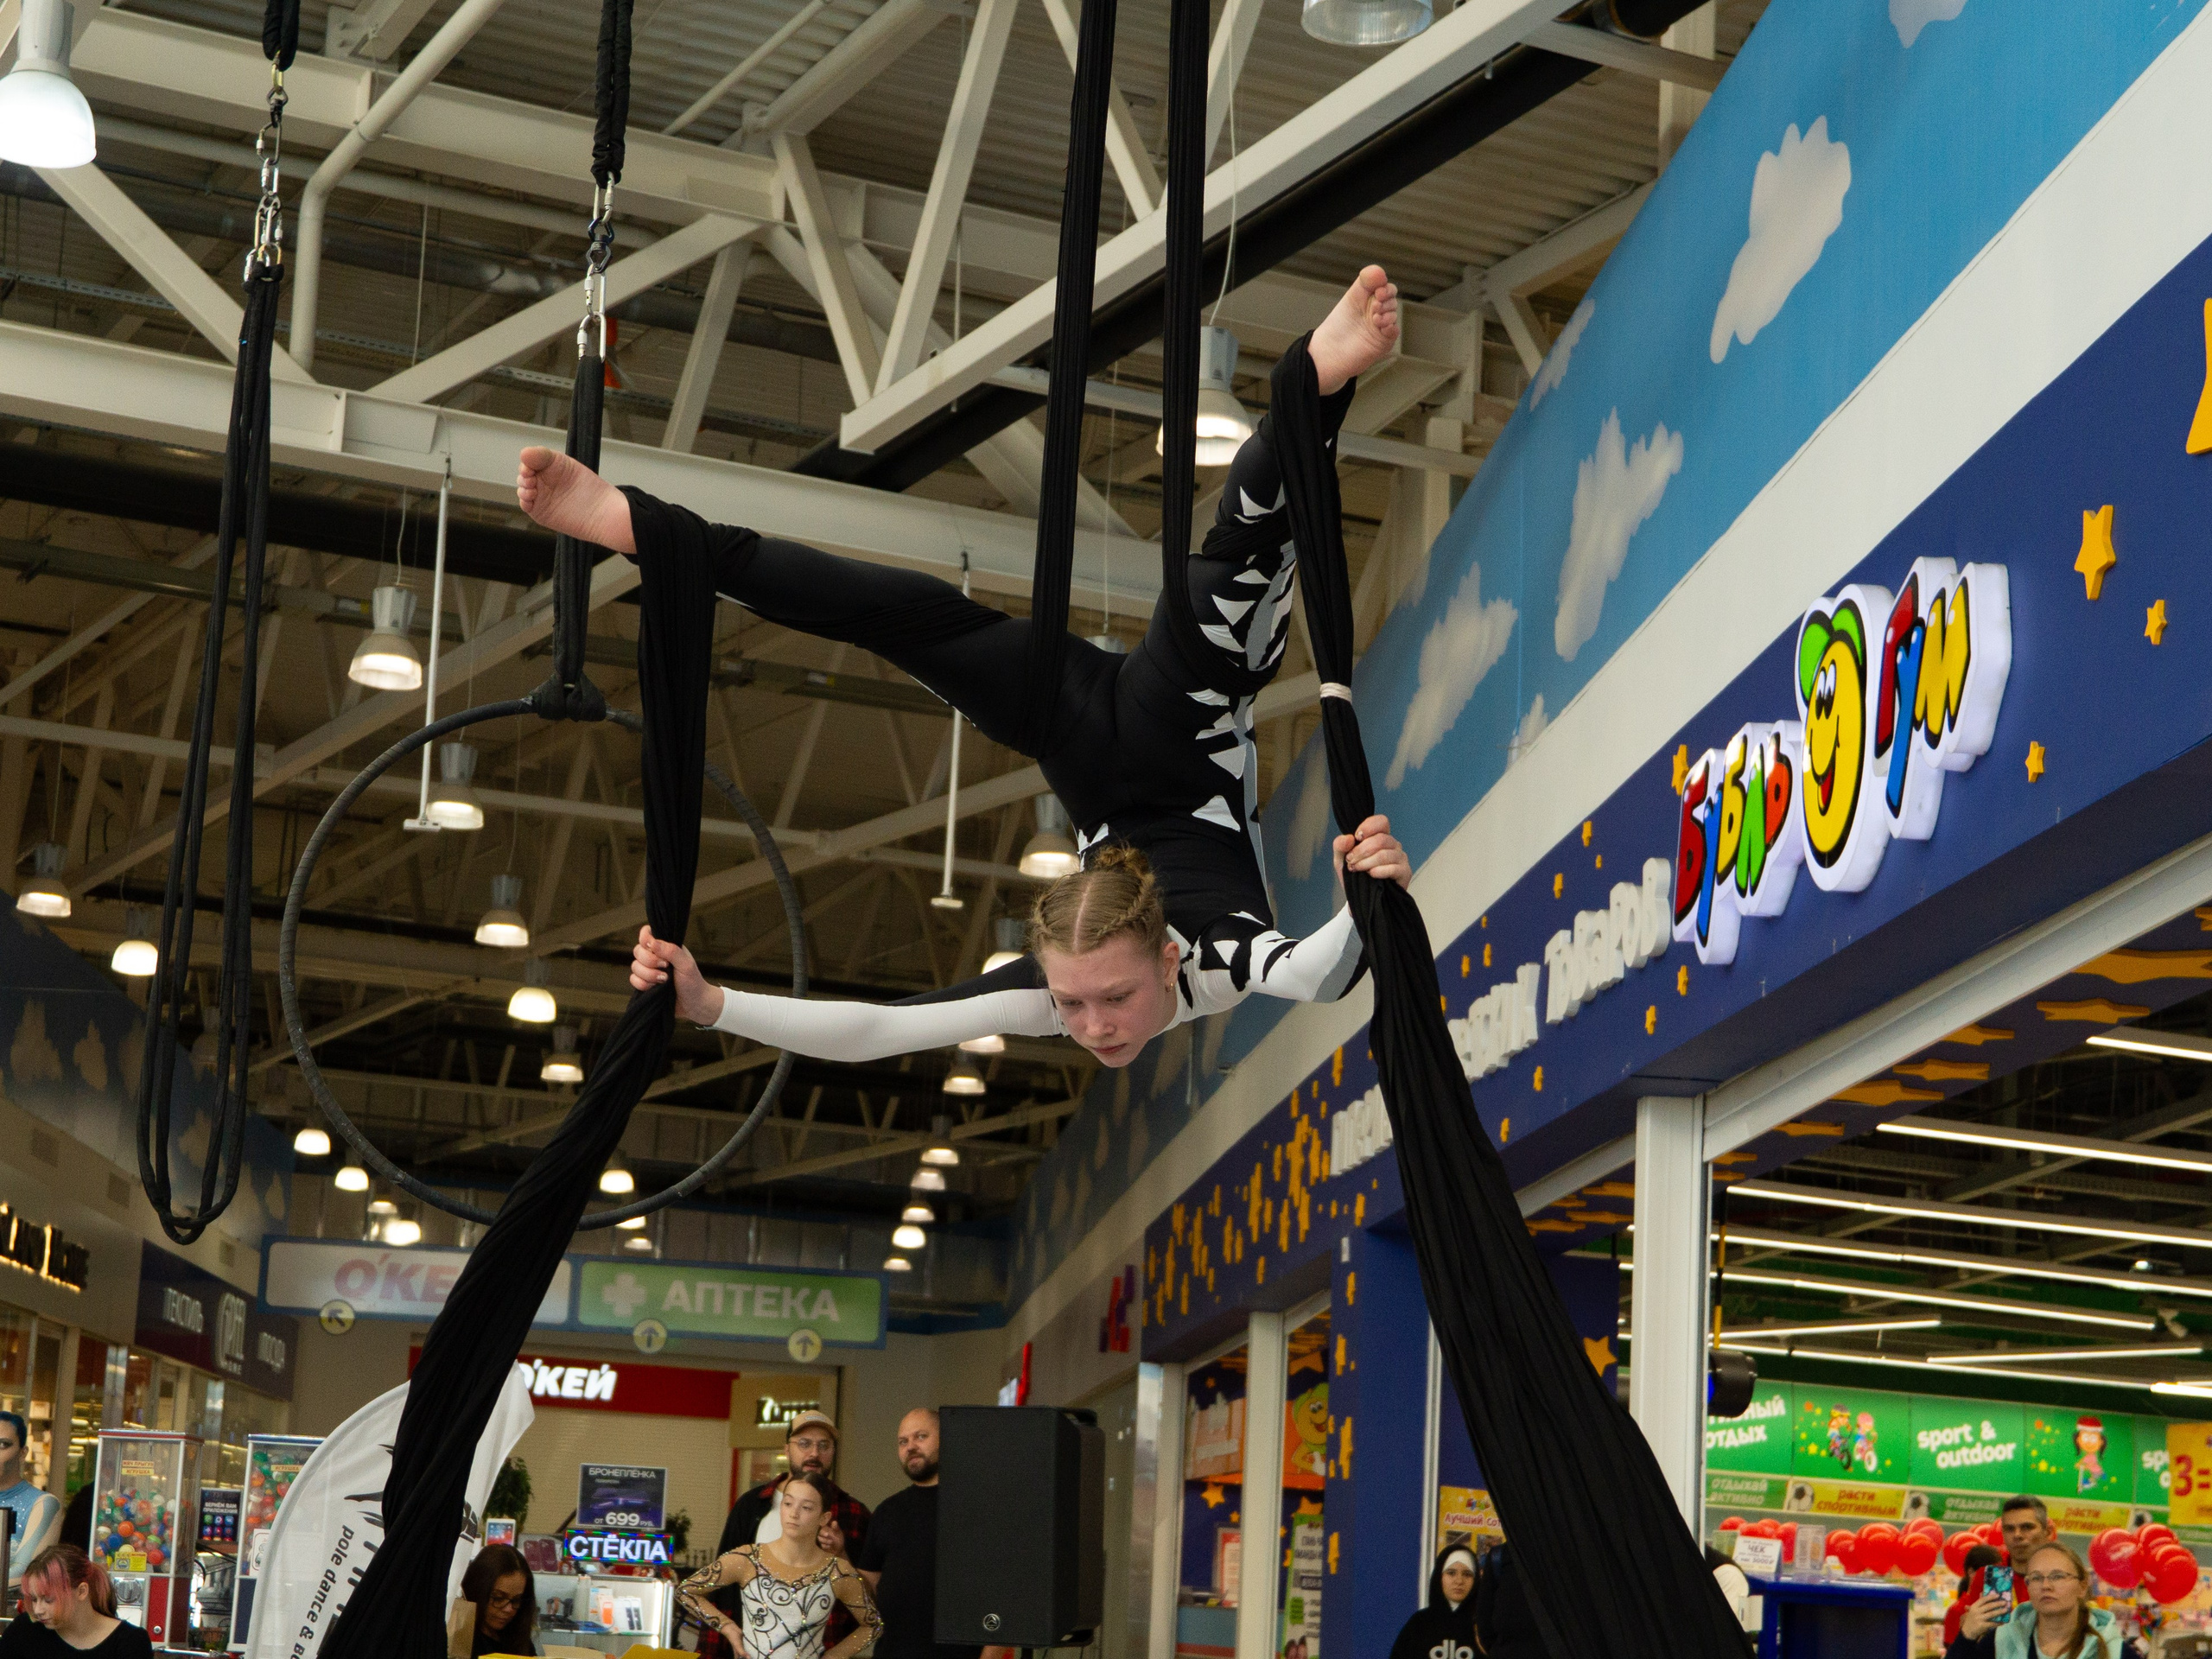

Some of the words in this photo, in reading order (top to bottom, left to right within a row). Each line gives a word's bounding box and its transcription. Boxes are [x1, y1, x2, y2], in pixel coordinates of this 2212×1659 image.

[662, 1280, 840, 1323] АПТЕКА
[1916, 1423, 1974, 1452] sport
[1980, 1420, 1997, 1441] &
[1936, 1442, 2017, 1469] outdoor
[605, 1511, 640, 1527] 699
[330, 1524, 355, 1567] pole
[569, 1534, 669, 1561] СТЁКЛА
[306, 1568, 337, 1624] dance
